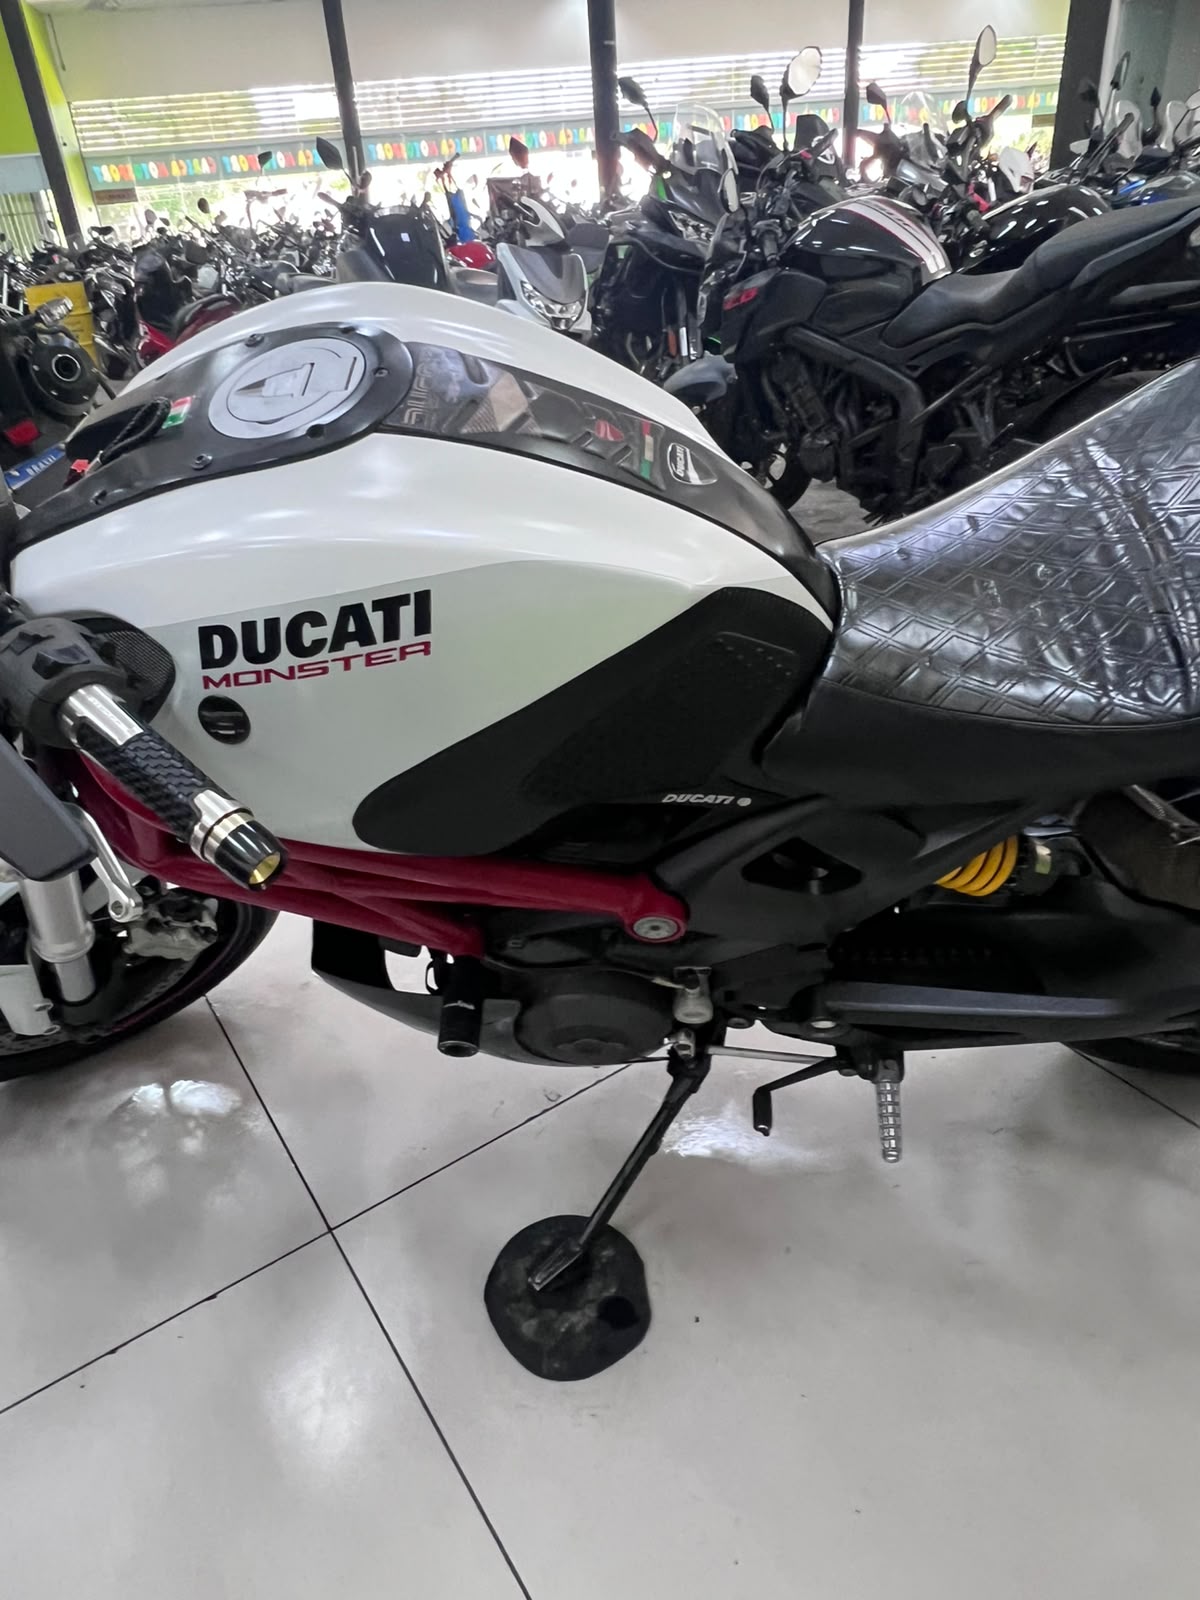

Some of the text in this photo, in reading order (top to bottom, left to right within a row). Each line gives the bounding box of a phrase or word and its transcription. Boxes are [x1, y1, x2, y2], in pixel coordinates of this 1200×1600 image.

[198, 589, 432, 670] DUCATI
[202, 641, 432, 690] MONSTER
[661, 793, 735, 805] DUCATI
